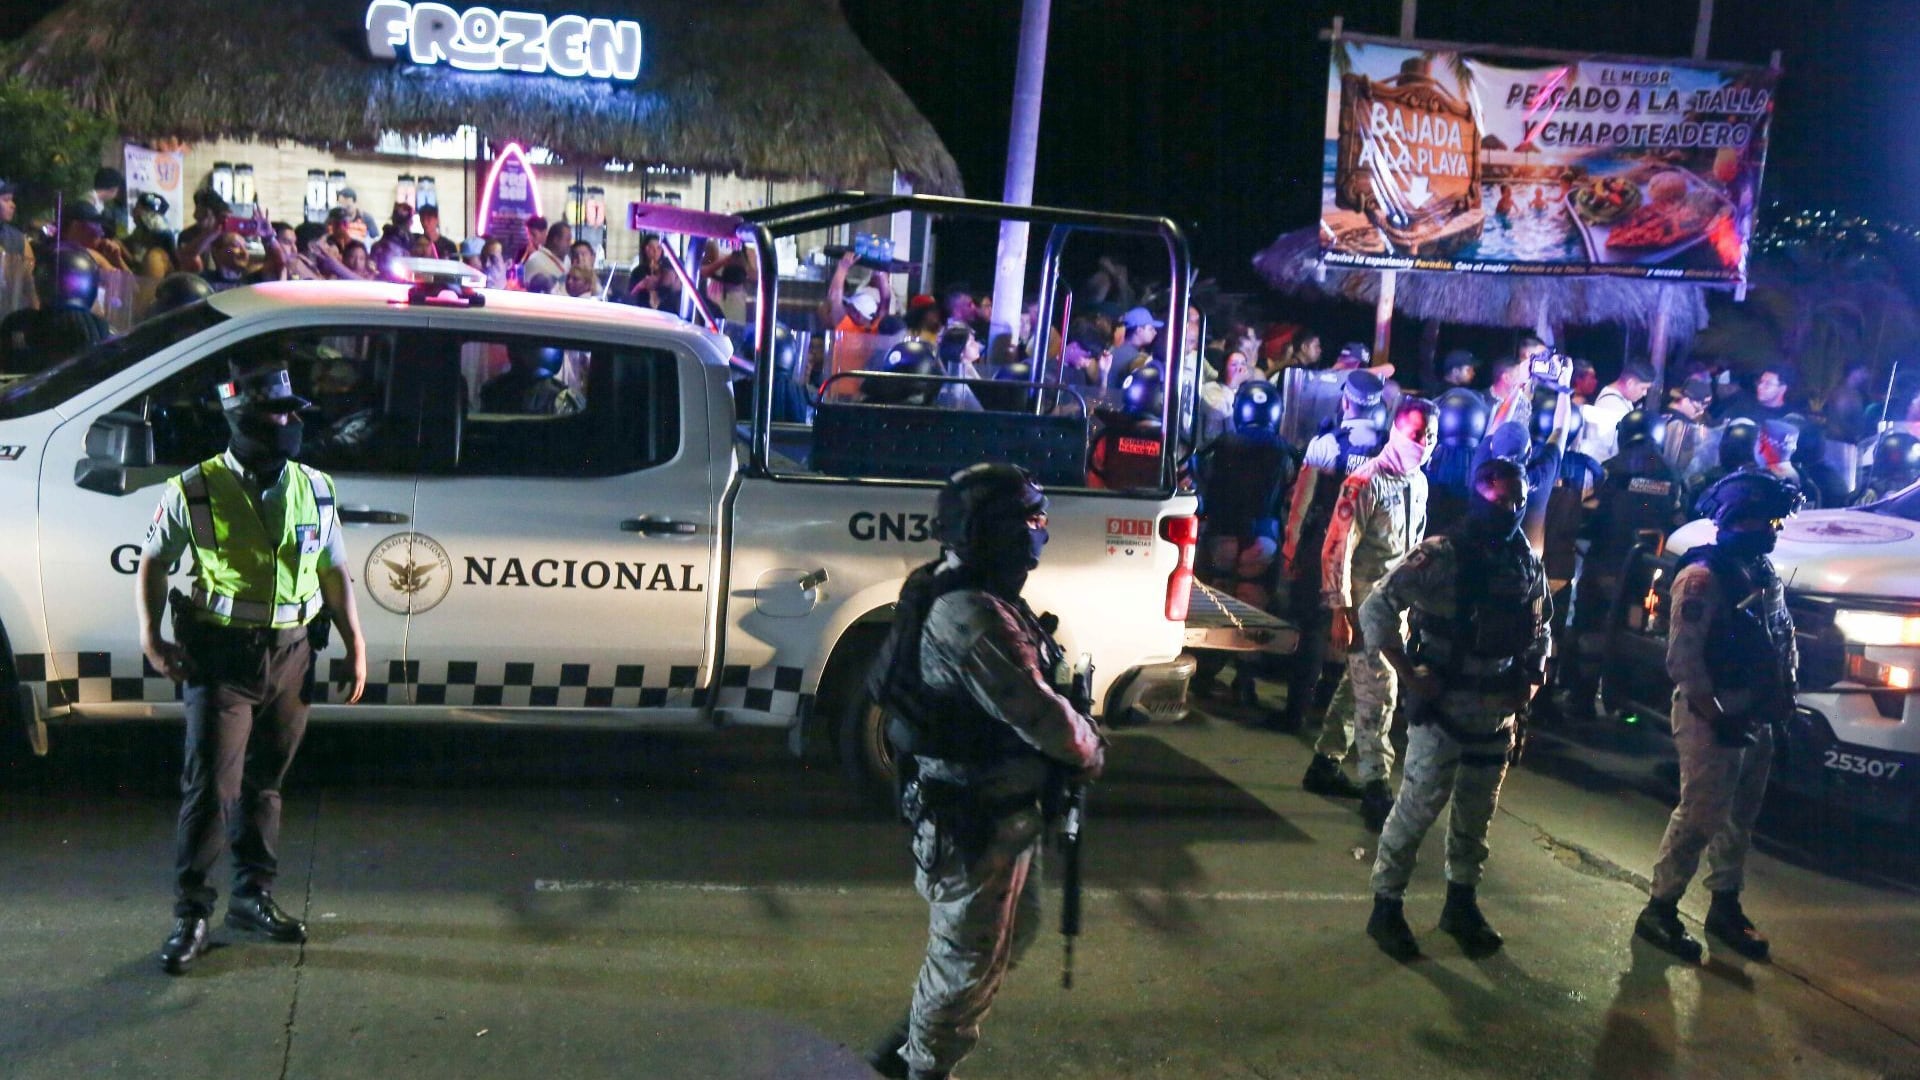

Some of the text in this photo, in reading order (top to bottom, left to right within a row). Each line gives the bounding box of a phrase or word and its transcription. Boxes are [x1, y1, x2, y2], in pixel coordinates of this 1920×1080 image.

[366, 0, 642, 80] FROZEN
[1601, 70, 1671, 84] EL MEJOR
[1506, 83, 1770, 115] PESCADO A LA TALLA
[1371, 102, 1463, 151] BAJADA
[1523, 120, 1751, 148] Y CHAPOTEADERO
[1416, 146, 1469, 177] PLAYA
[1365, 256, 1414, 269] experiencia
[1455, 261, 1472, 271] Con
[1484, 262, 1509, 273] mejor
[848, 511, 932, 542] GN3
[1109, 520, 1150, 534] 911
[463, 556, 704, 592] NACIONAL
[1824, 749, 1900, 778] 25307
